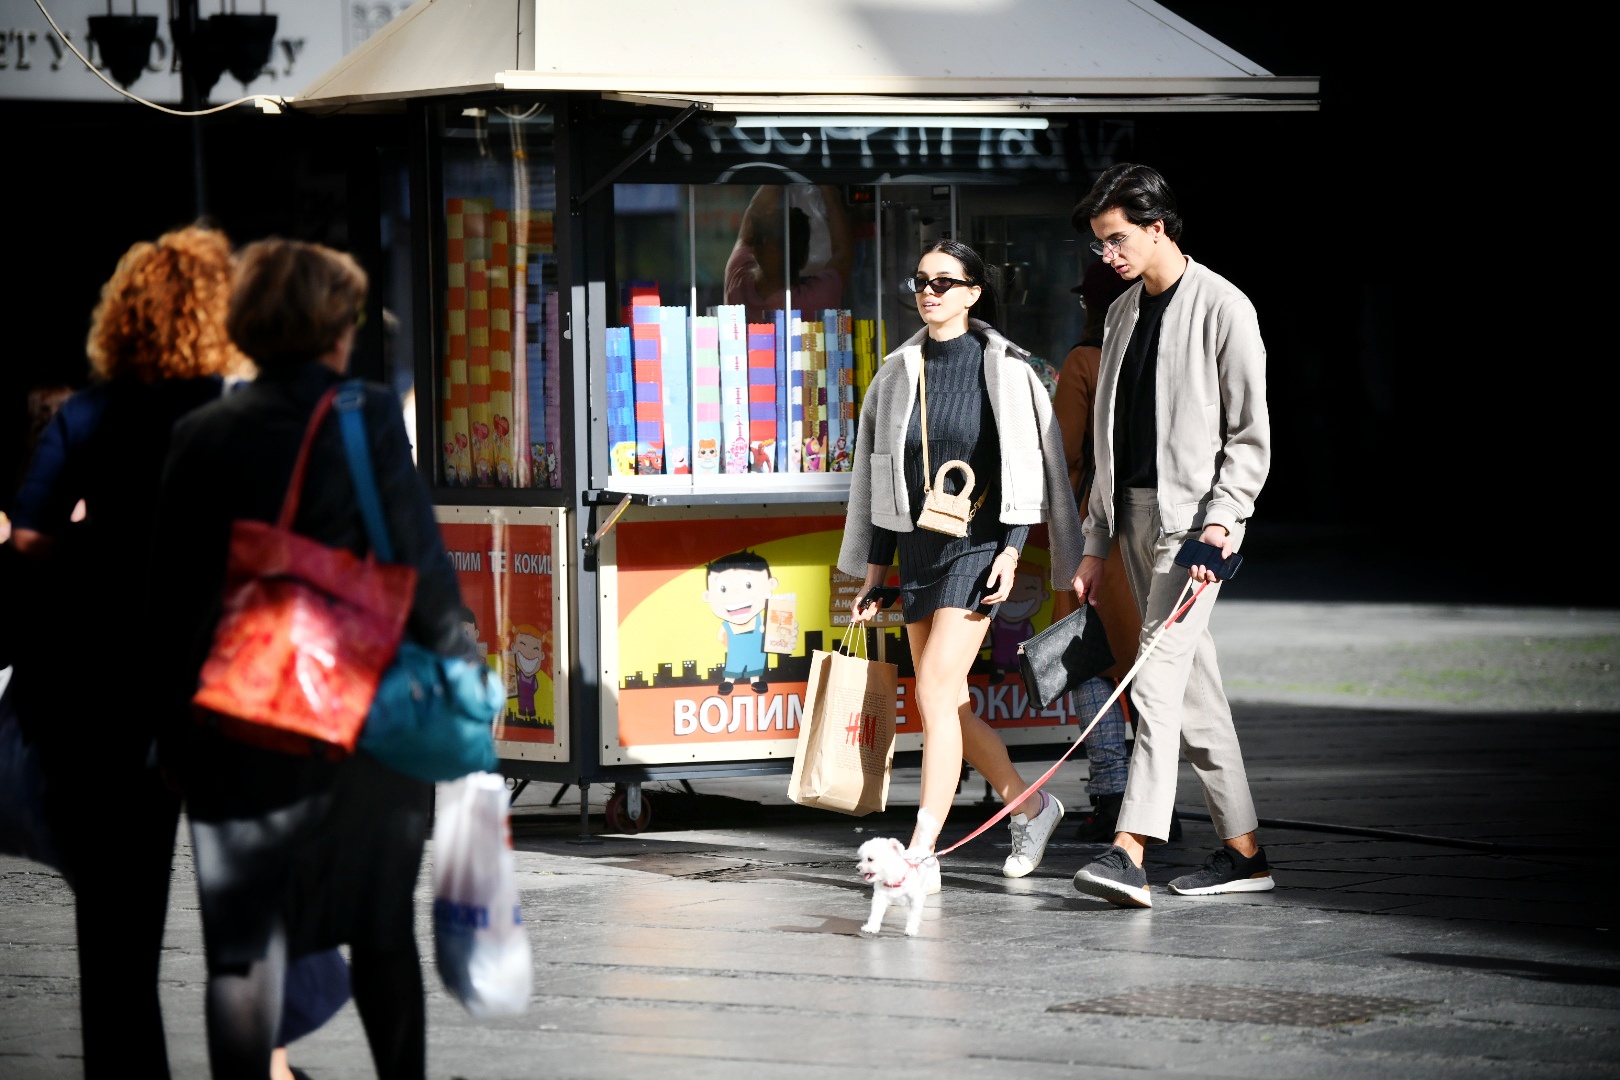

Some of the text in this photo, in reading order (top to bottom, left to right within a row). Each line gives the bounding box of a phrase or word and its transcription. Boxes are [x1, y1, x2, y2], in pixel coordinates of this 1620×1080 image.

[447, 551, 481, 572] ОЛИМ
[833, 615, 851, 624] ВОЛ
[845, 712, 877, 752] H&M
